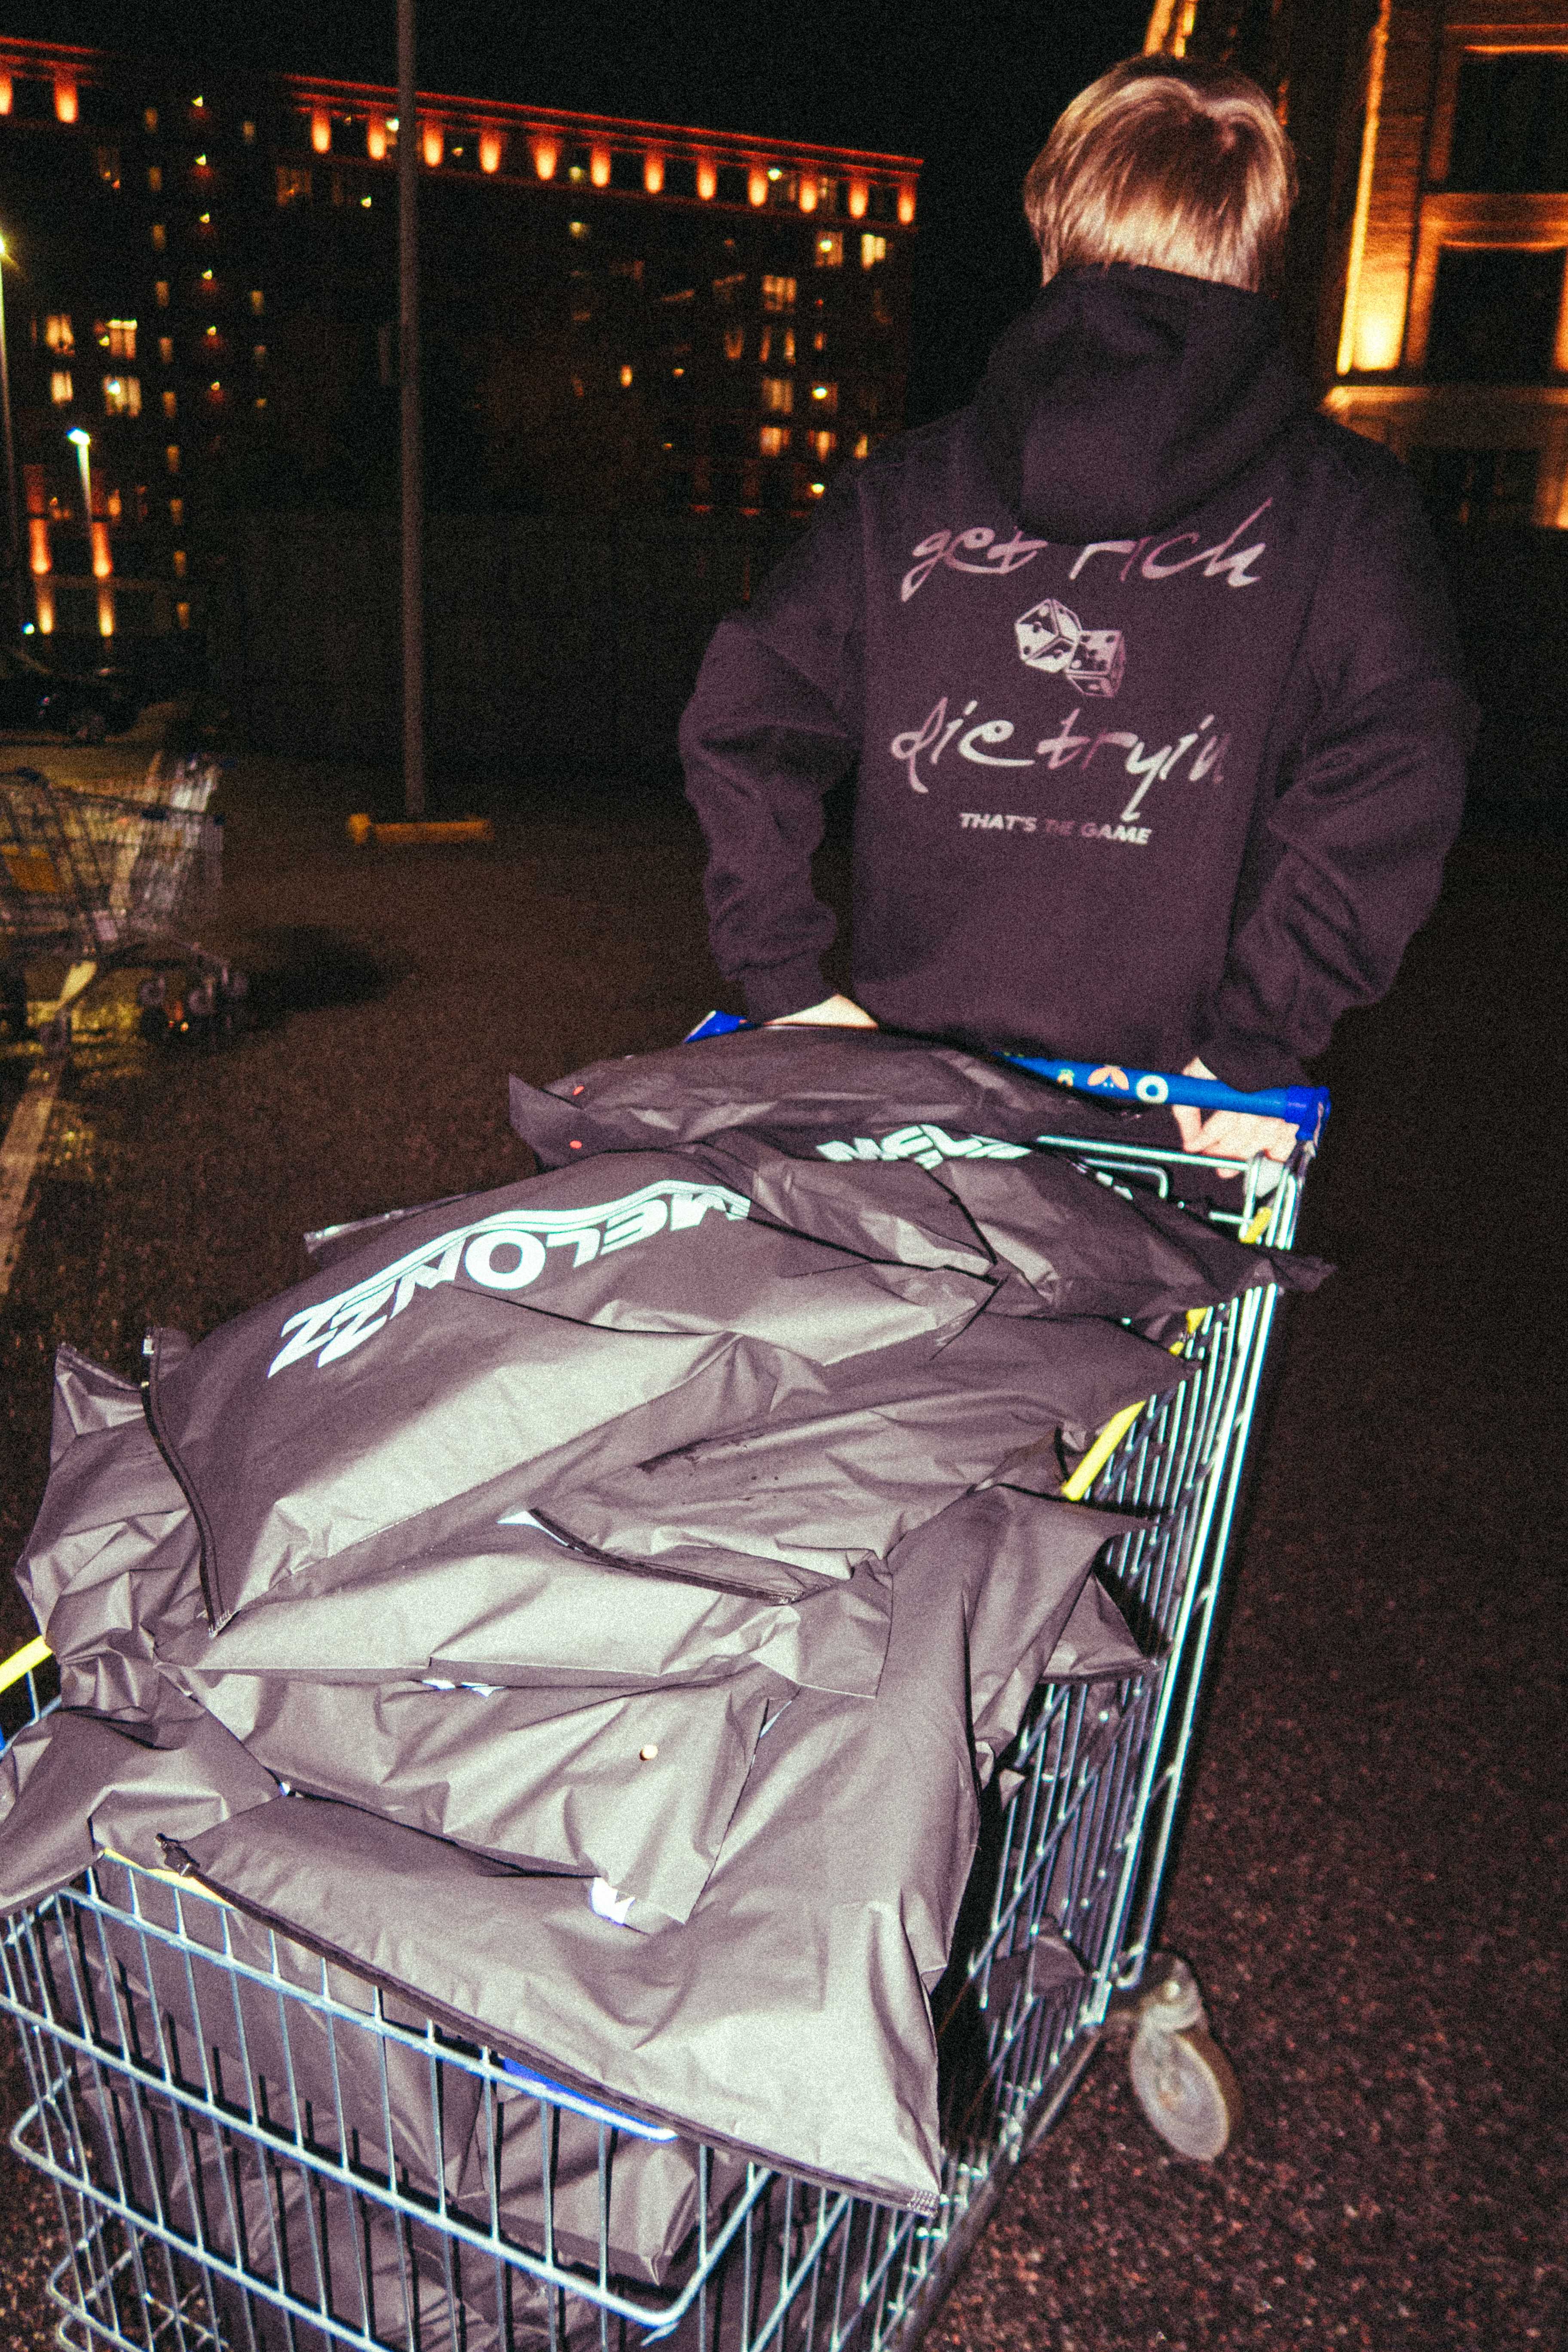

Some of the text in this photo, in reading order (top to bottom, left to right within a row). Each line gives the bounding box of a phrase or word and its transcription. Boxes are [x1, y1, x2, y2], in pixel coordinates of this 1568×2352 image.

[902, 497, 1272, 602] get rich
[891, 697, 1230, 821] die tryin
[959, 812, 1038, 833] THAT'S
[1081, 822, 1152, 845] GAME
